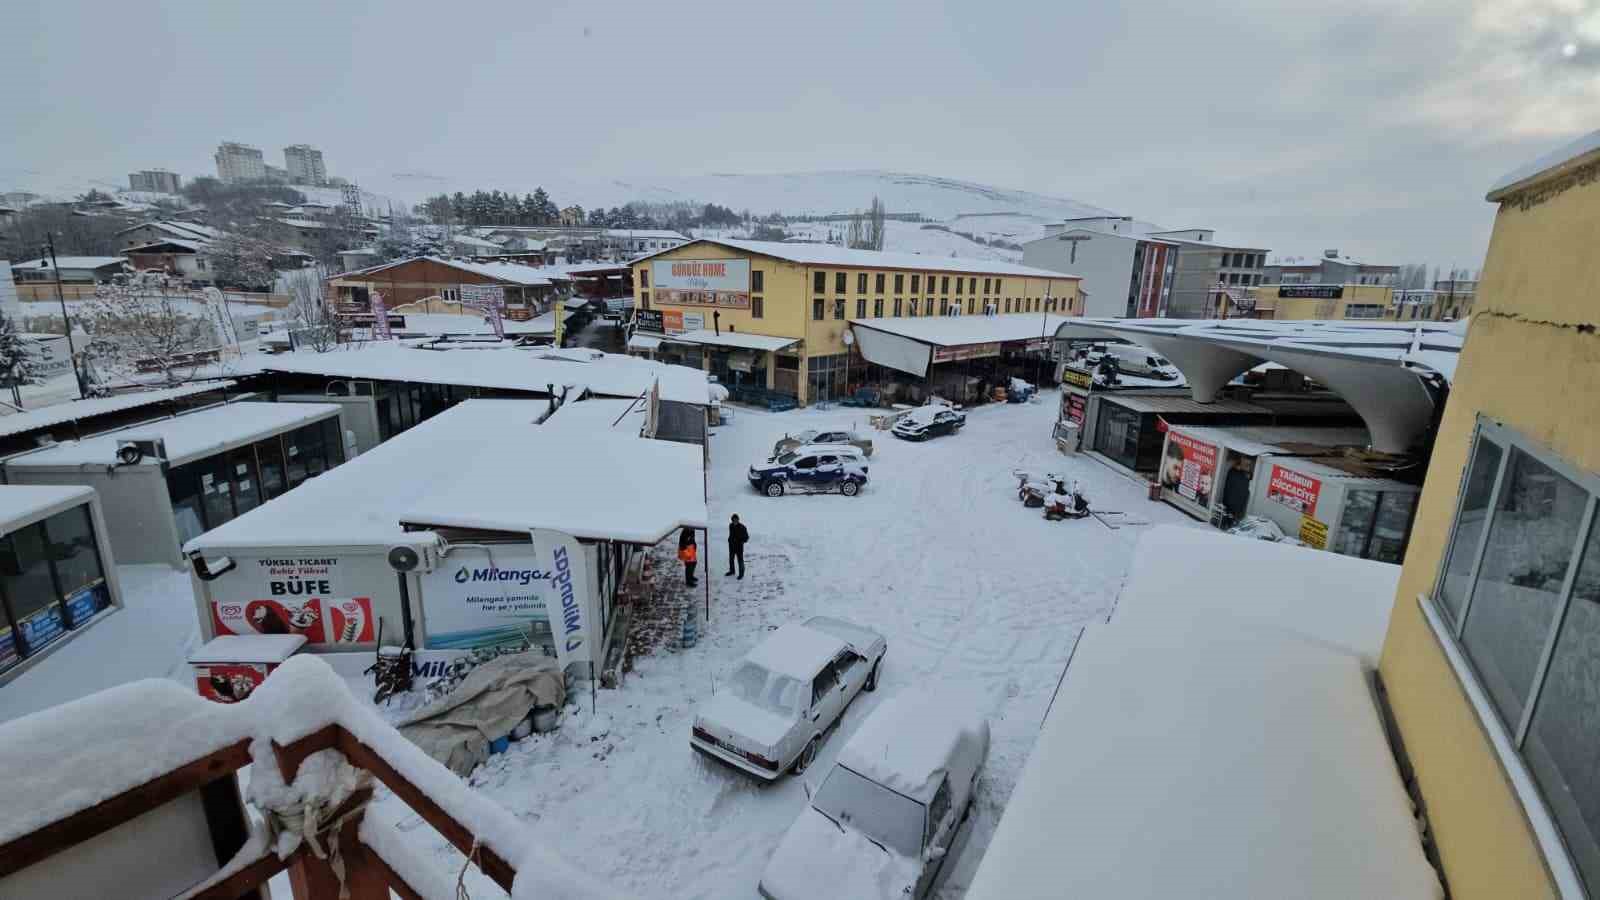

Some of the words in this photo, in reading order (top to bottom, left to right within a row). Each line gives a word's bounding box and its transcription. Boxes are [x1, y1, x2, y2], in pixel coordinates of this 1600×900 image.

[473, 567, 551, 585] Milangaz
[270, 576, 331, 596] BÜFE
[466, 595, 504, 604] Milangaz
